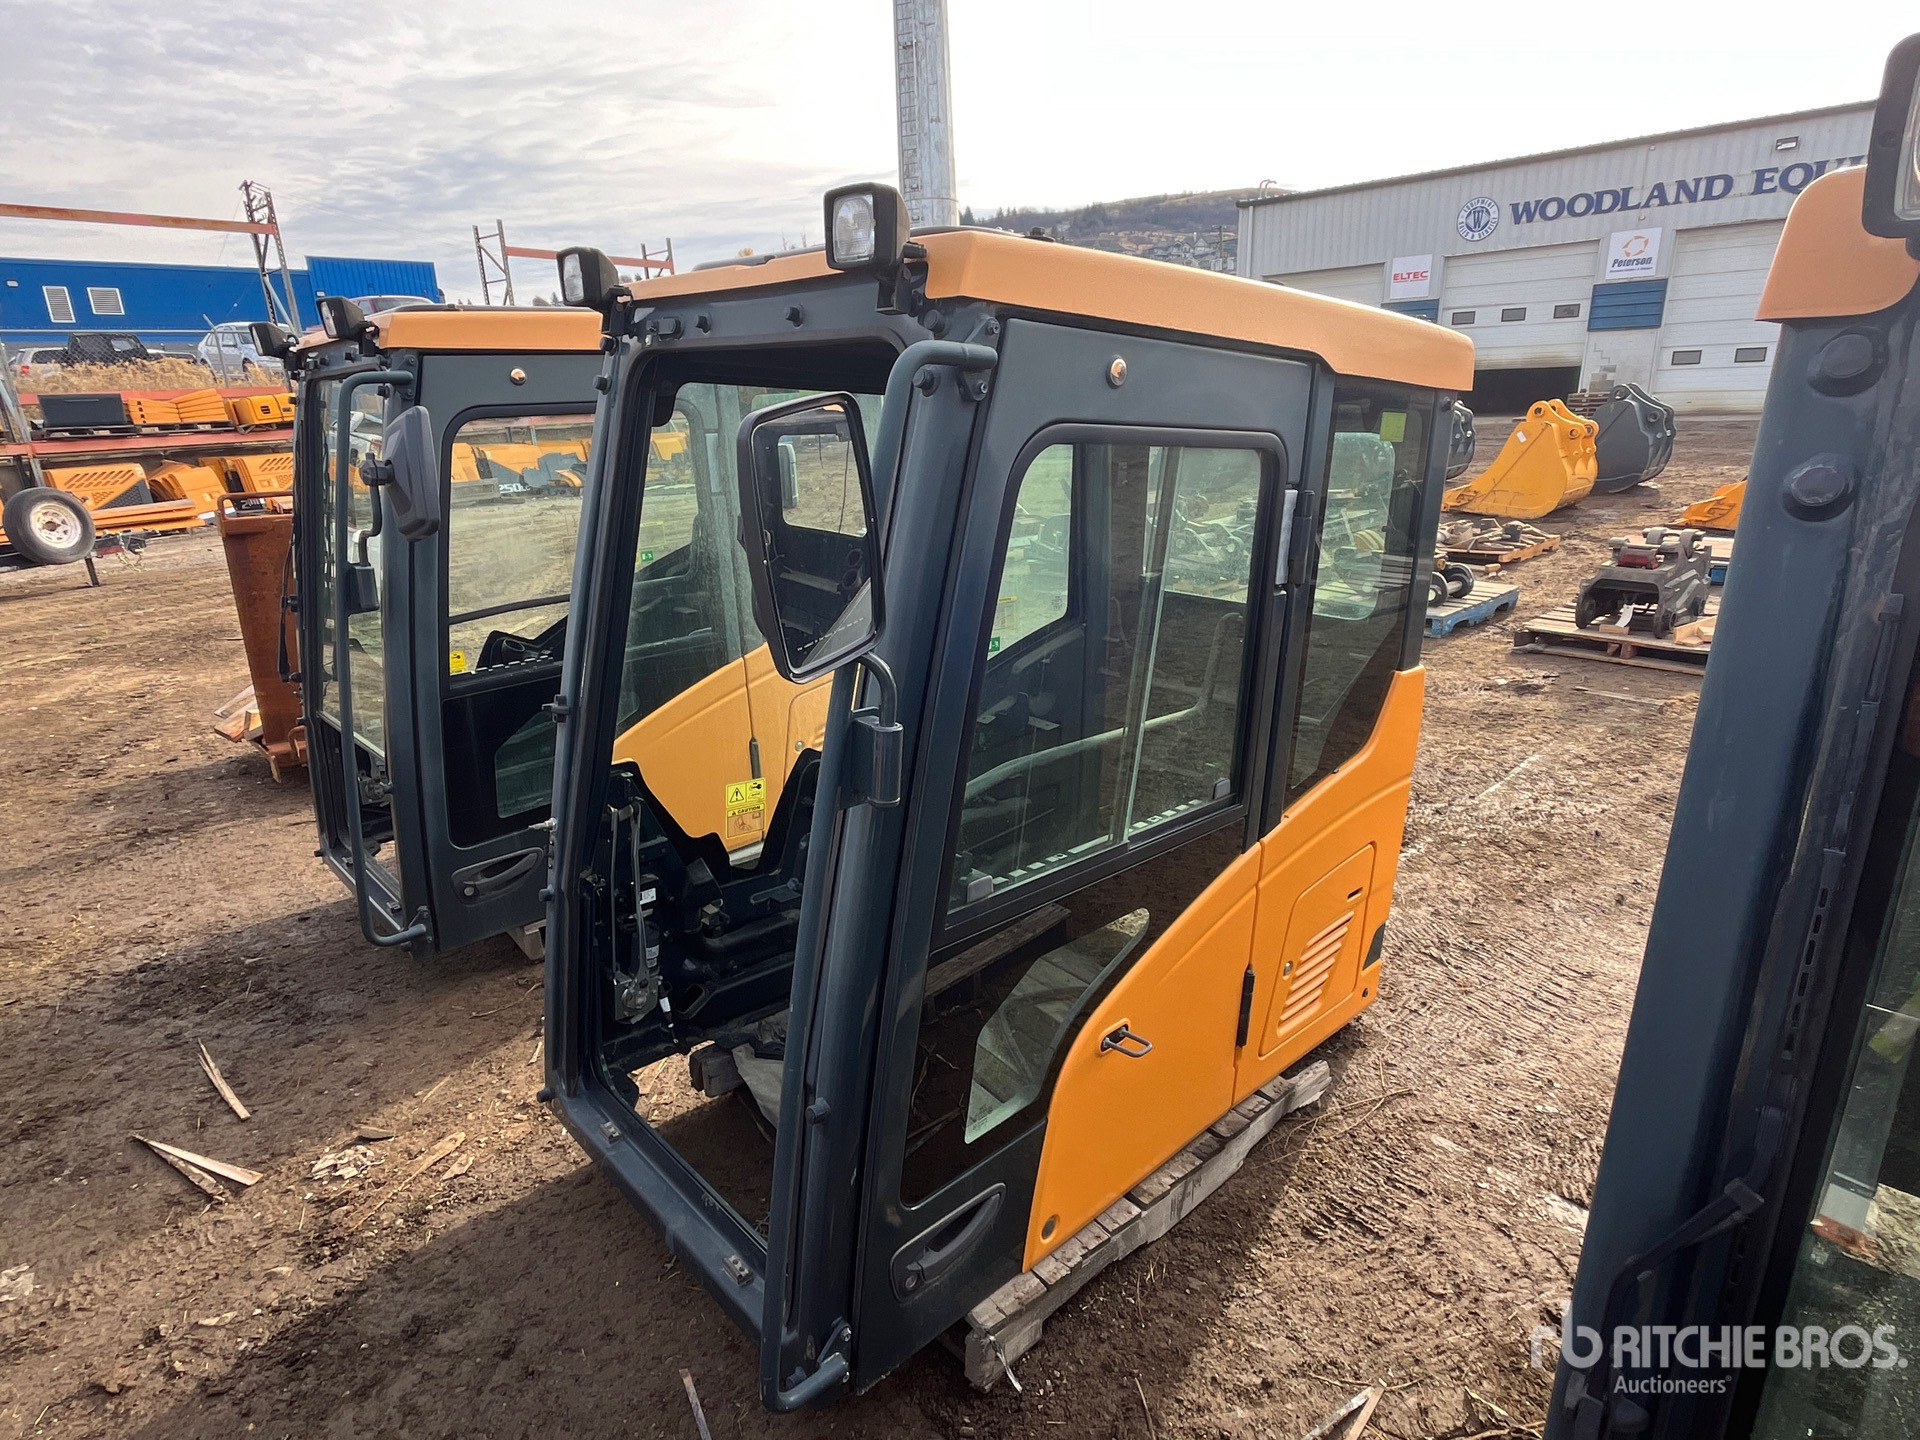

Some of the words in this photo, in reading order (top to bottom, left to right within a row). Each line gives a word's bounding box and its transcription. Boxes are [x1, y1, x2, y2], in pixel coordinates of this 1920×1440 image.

[1509, 173, 1734, 225] WOODLAND
[1472, 209, 1485, 229] W
[1611, 257, 1653, 268] Peterson
[1393, 270, 1429, 281] ELTEC
[737, 805, 761, 814] CAUTION
